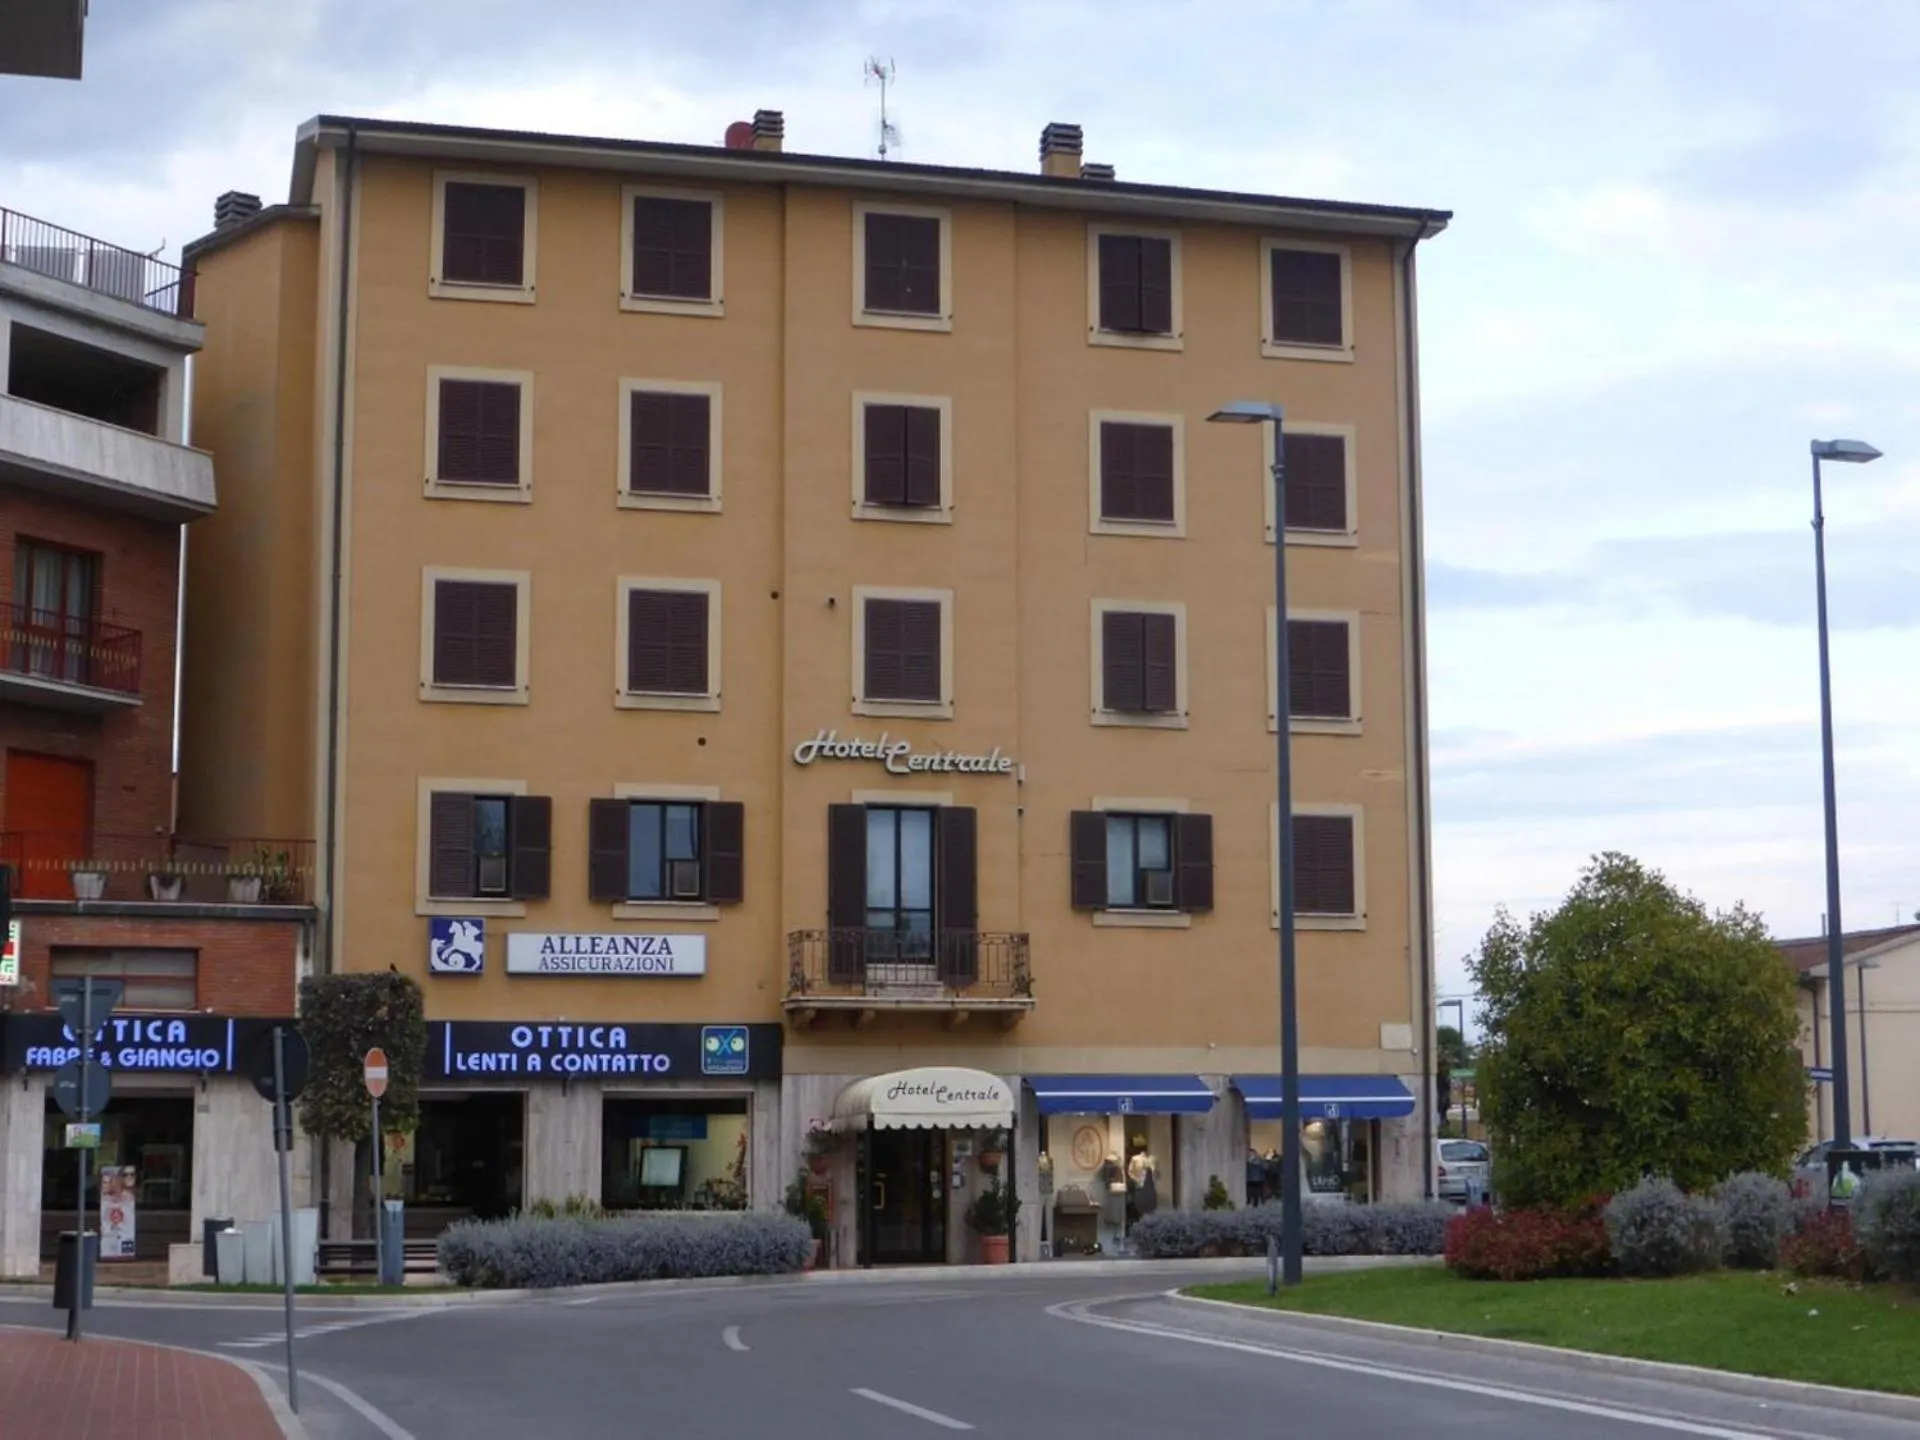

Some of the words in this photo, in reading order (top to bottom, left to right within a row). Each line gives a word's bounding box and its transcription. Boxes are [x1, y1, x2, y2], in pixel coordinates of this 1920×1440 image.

[795, 729, 888, 764] Hotel
[885, 742, 1013, 773] Centrale
[540, 936, 673, 955] ALLEANZA
[538, 956, 675, 971] ASSICURAZIONI
[511, 1026, 627, 1048] OTTICA
[100, 1051, 113, 1067] &
[118, 1048, 220, 1068] GIANGIO
[456, 1053, 518, 1071] LENTI
[527, 1053, 542, 1071] A
[550, 1054, 671, 1072] CONTATTO
[887, 1081, 936, 1100] Hotel
[936, 1085, 1000, 1103] Centrale
